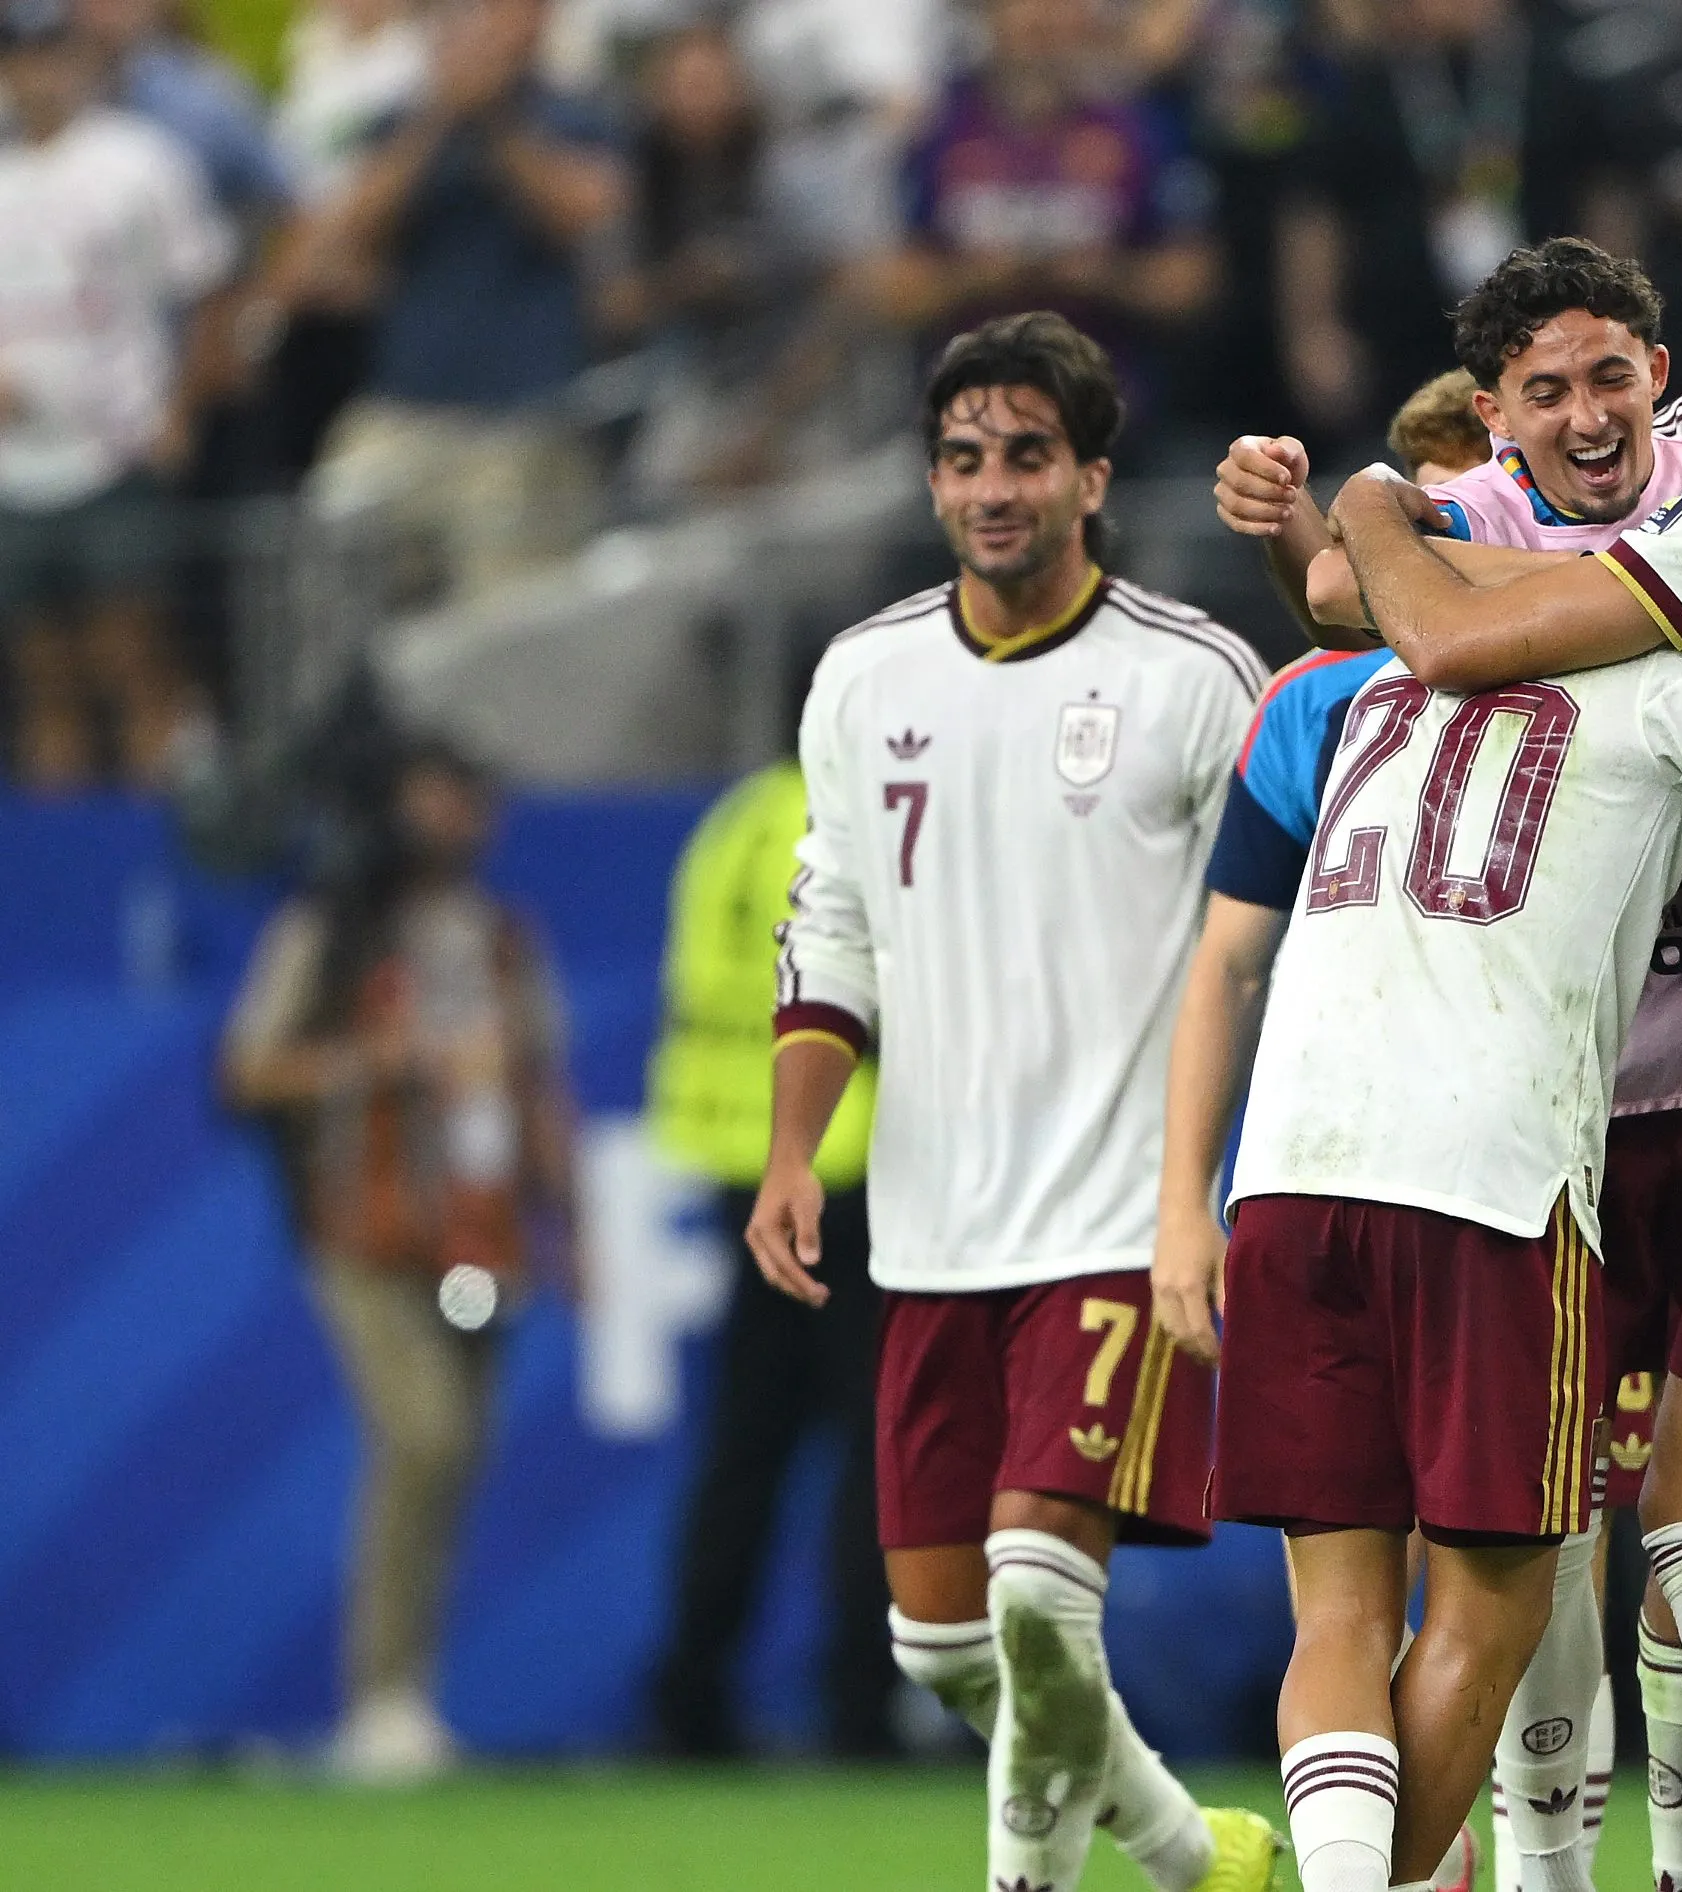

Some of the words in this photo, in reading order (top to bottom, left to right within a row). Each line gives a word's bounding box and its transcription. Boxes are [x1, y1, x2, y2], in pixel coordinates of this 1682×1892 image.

[883, 782, 929, 888] 7
[1306, 674, 1581, 926] 20
[1079, 1298, 1139, 1408] 7
